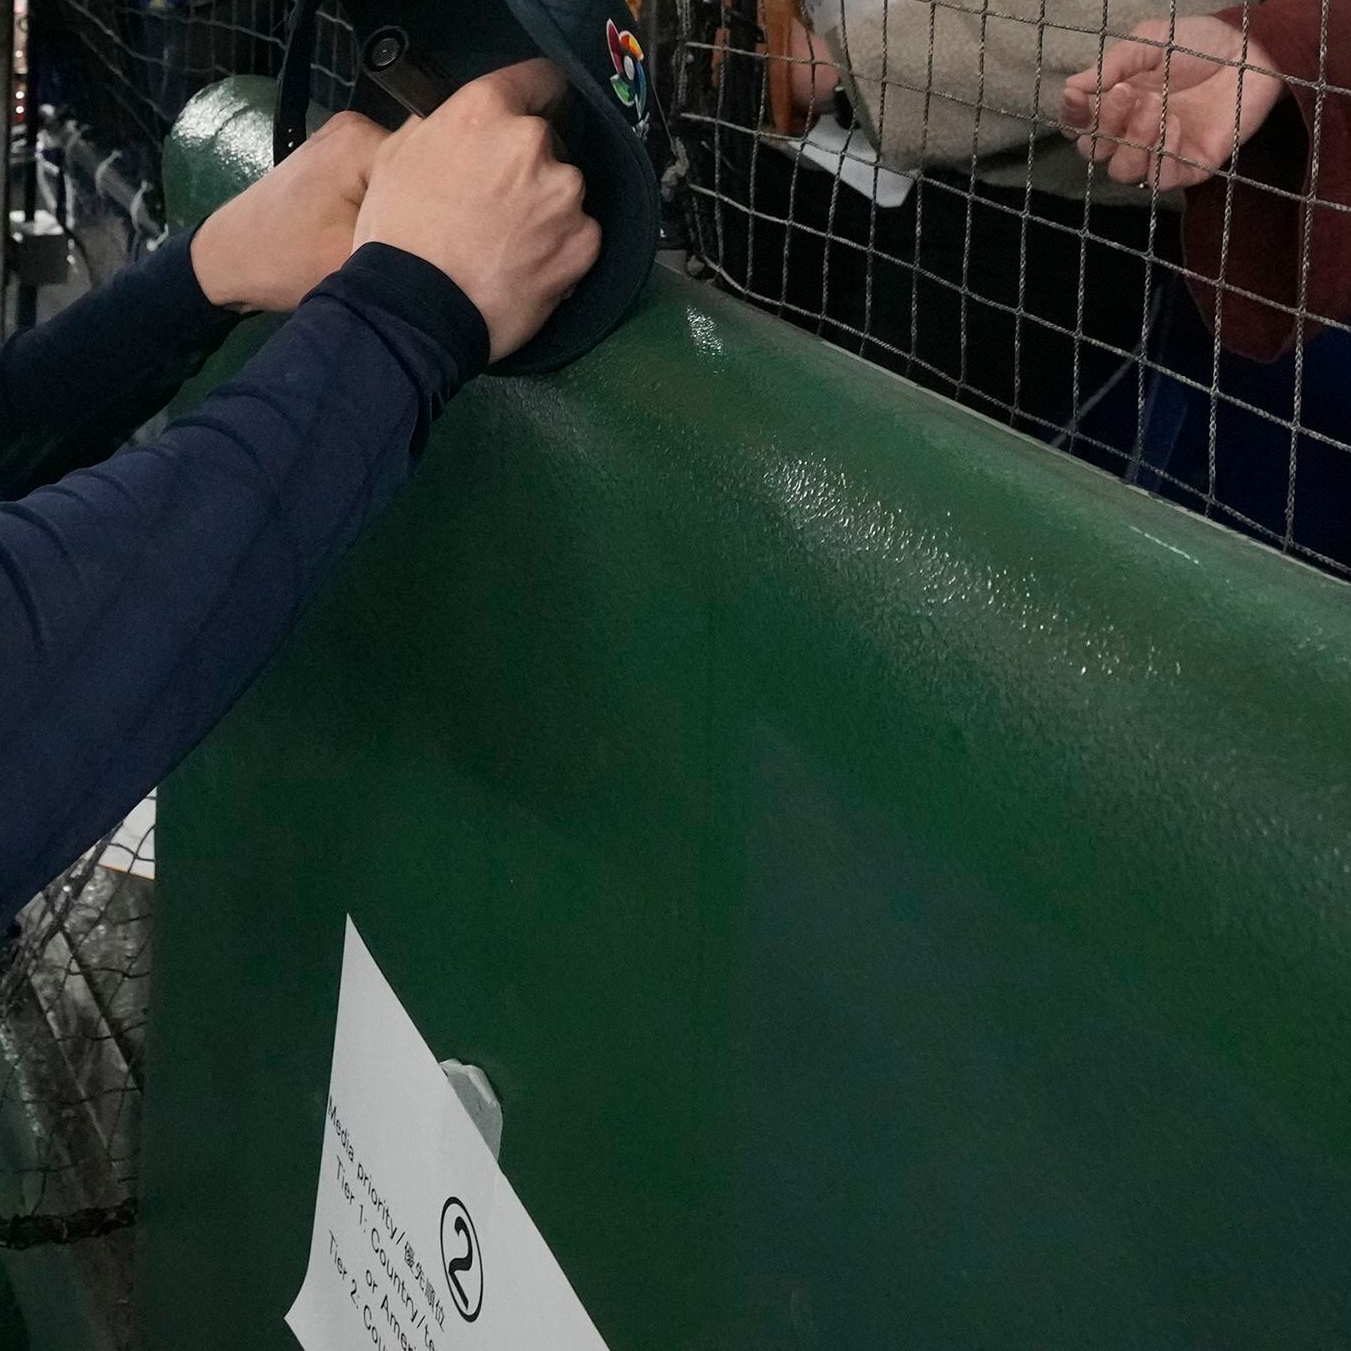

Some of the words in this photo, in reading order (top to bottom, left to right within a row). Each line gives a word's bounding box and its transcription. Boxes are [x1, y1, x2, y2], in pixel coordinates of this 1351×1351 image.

[328, 1095, 354, 1162] Media
[336, 1154, 355, 1205] Tier
[359, 1204, 368, 1233] 1:
[329, 1228, 348, 1281] Tier
[350, 1278, 360, 1309] 2:
[365, 1269, 378, 1293] or
